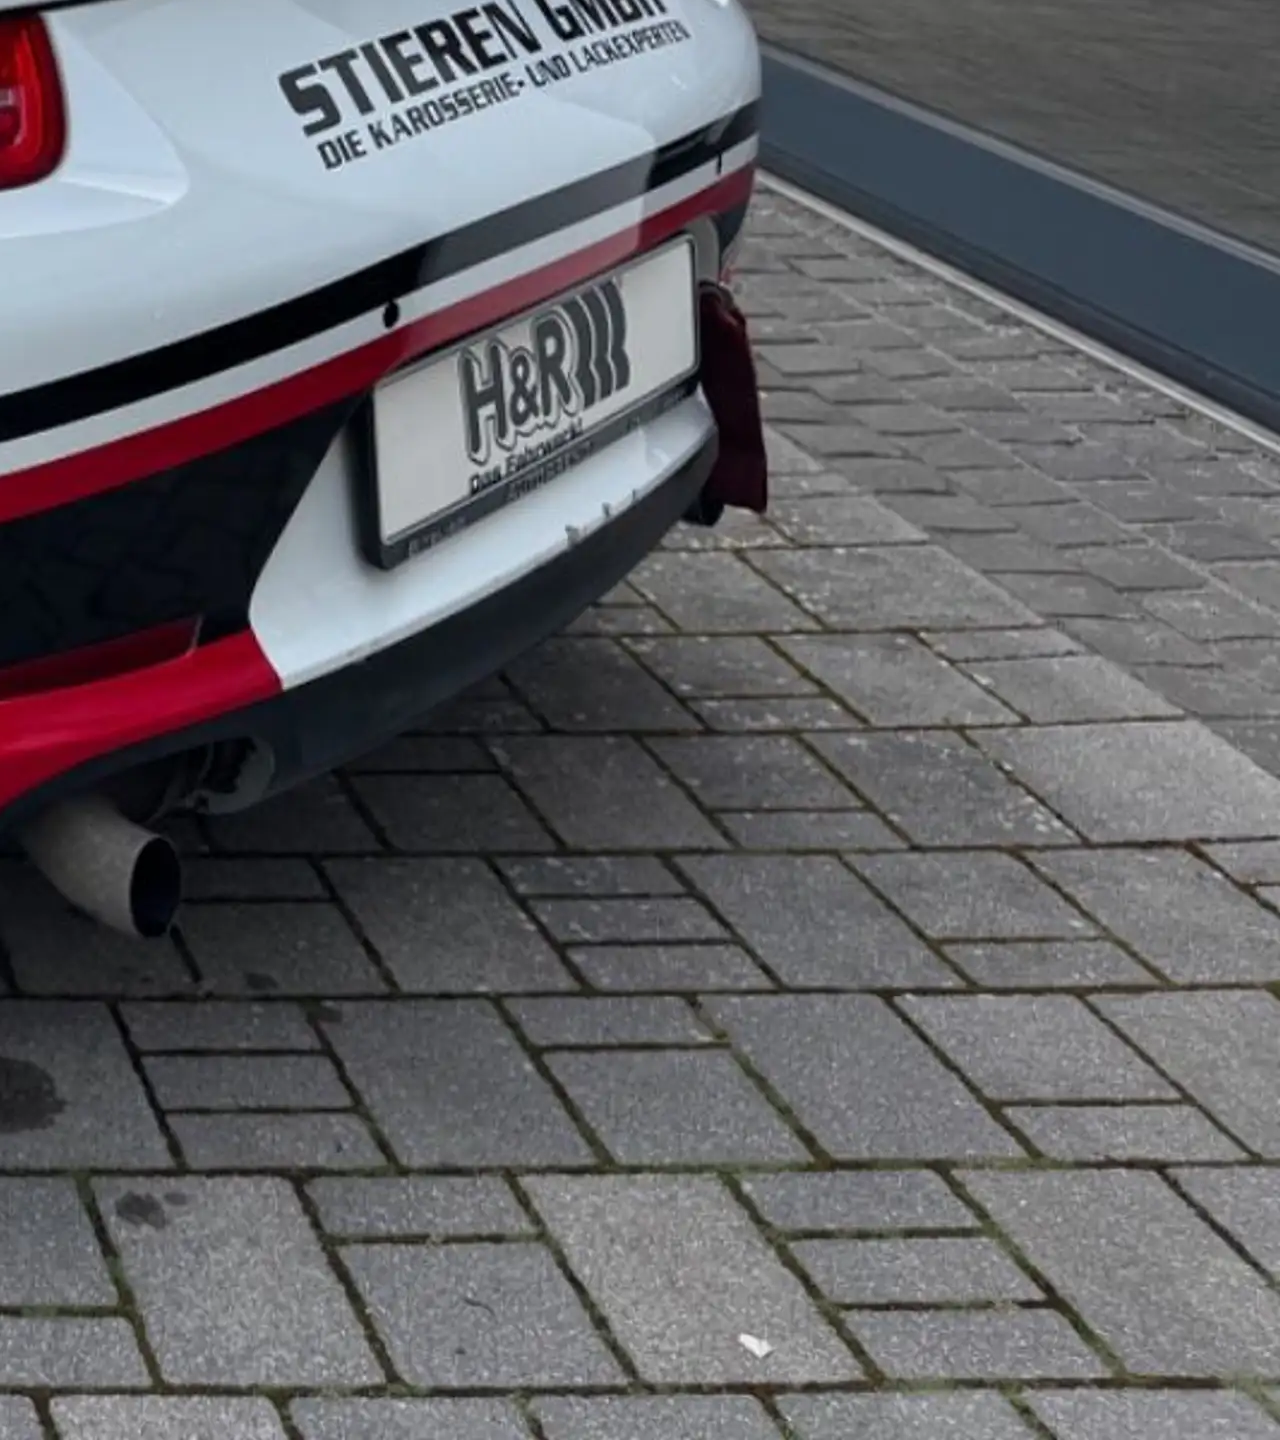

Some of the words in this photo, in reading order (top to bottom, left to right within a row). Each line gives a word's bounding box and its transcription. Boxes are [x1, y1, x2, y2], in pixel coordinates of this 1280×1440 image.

[317, 134, 367, 171] DIE
[528, 55, 572, 90] UND
[567, 18, 692, 73] LACKEXPERTEN
